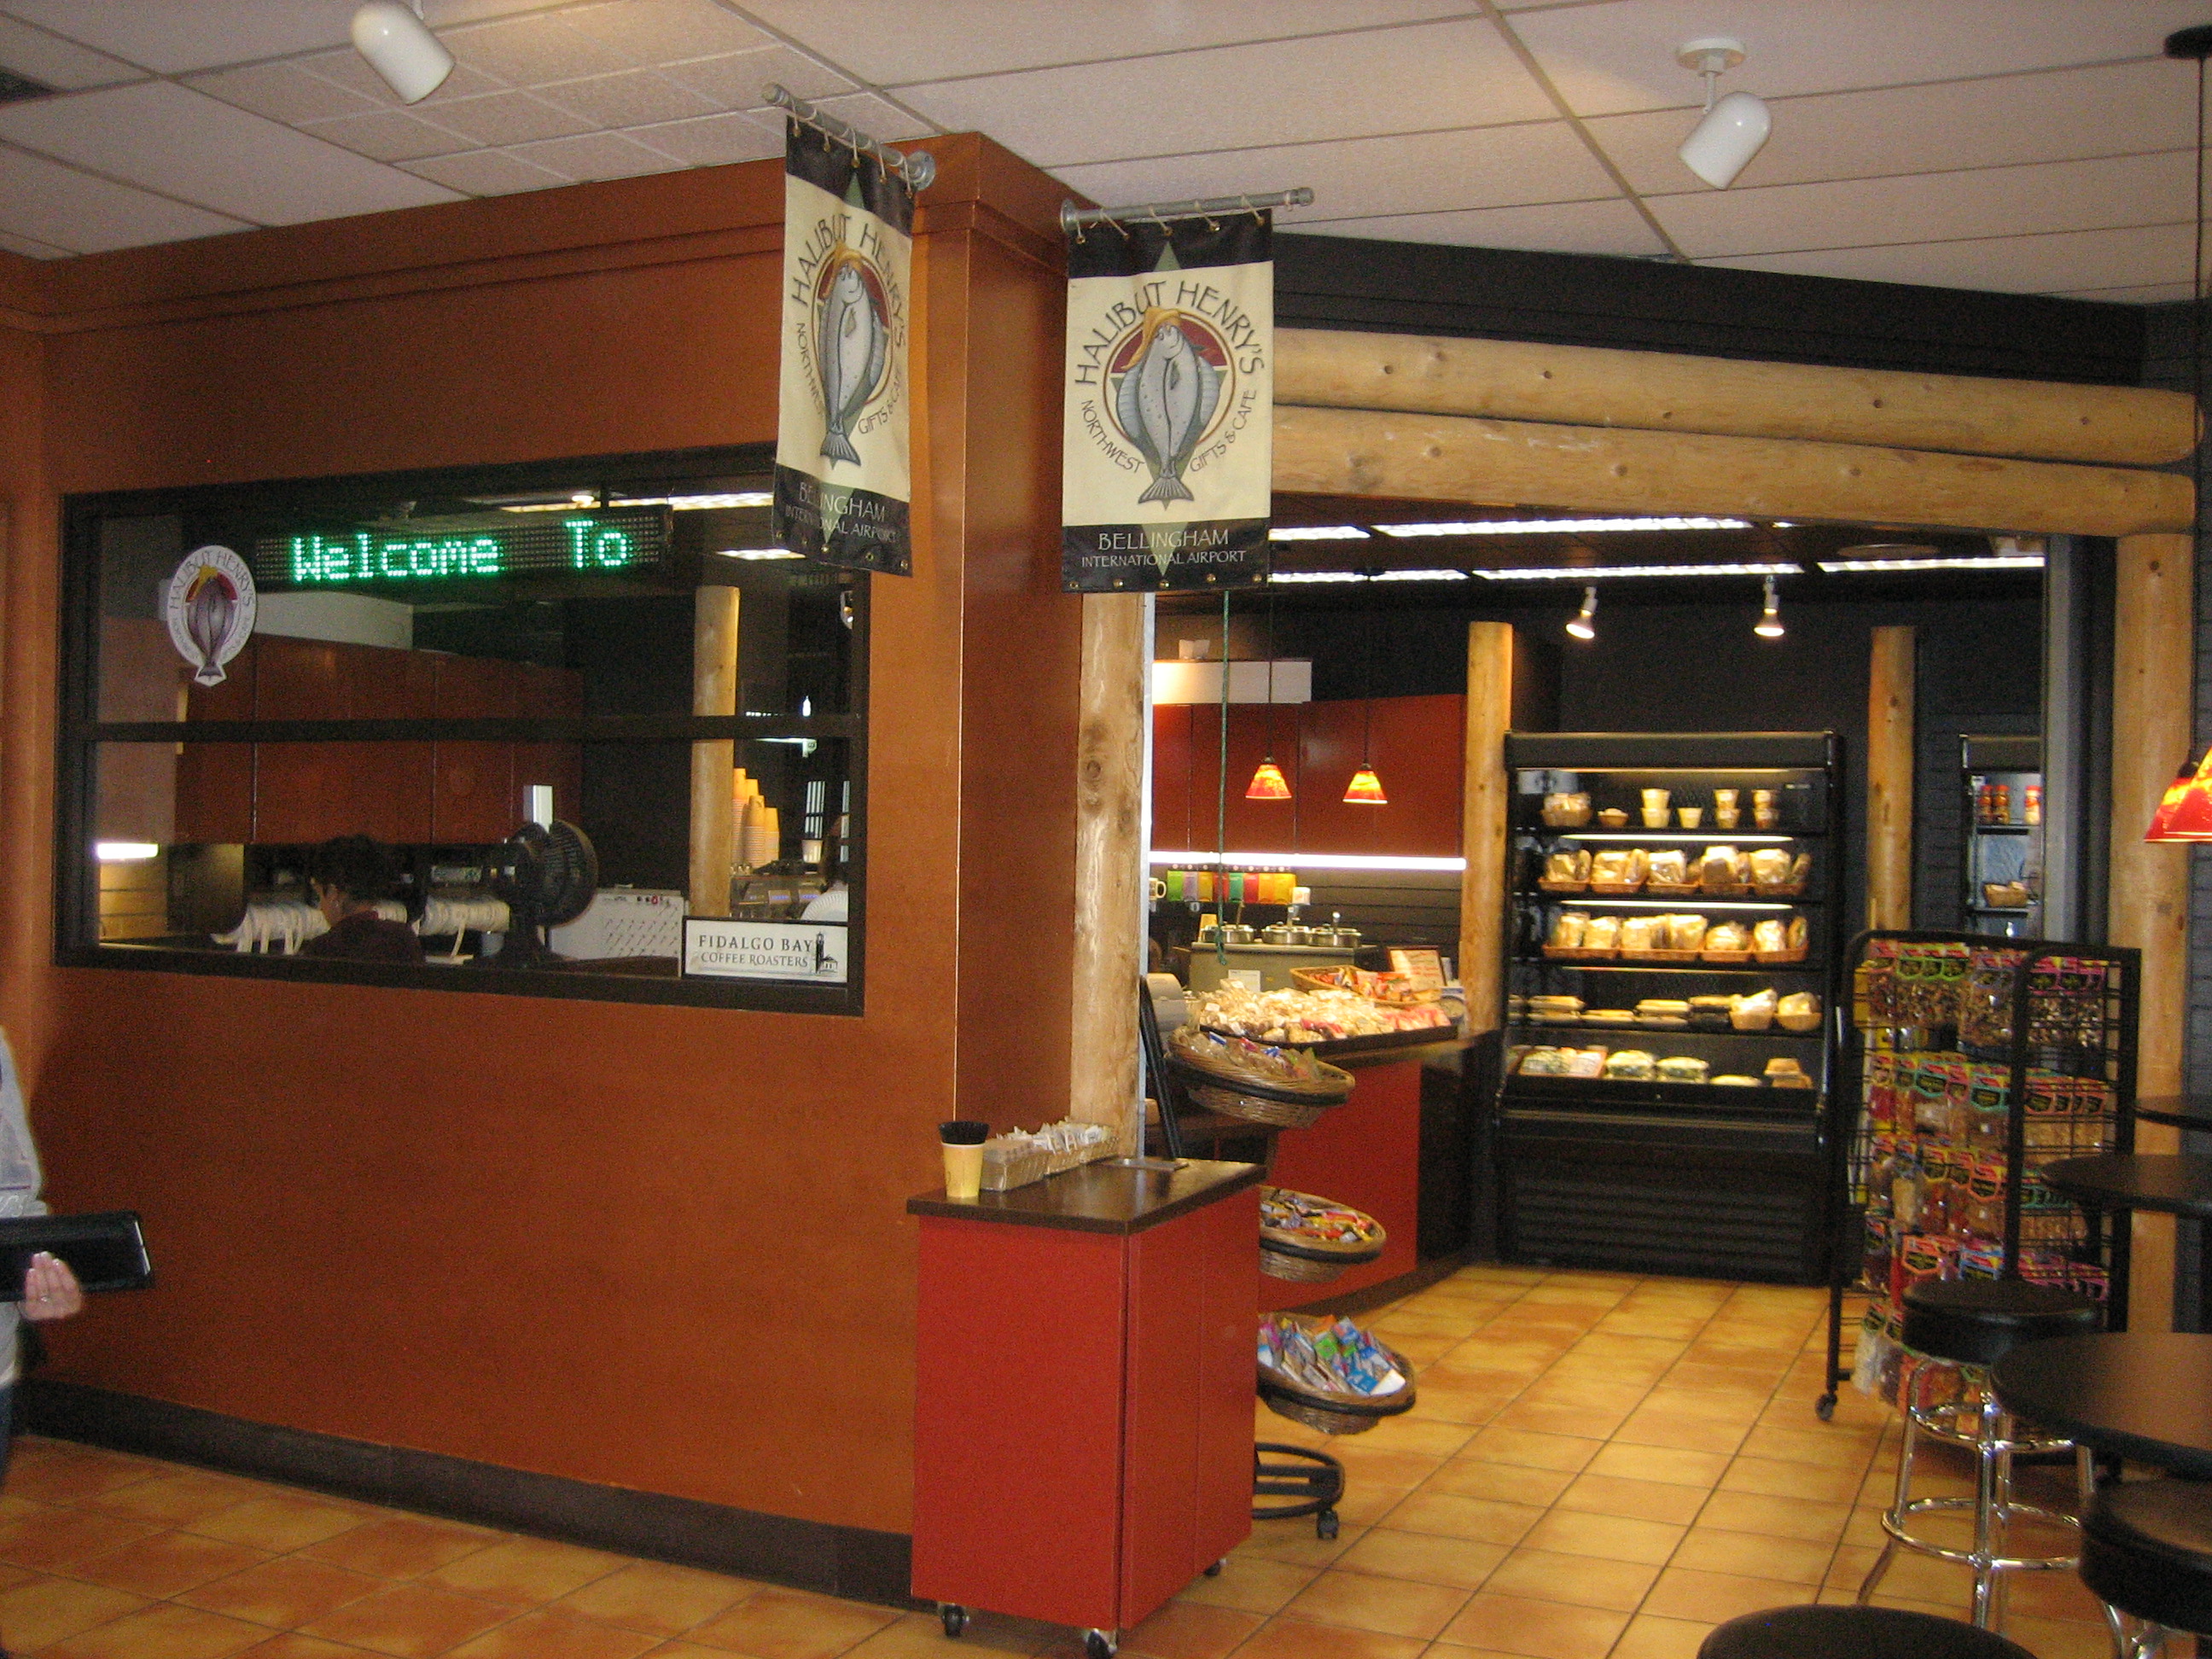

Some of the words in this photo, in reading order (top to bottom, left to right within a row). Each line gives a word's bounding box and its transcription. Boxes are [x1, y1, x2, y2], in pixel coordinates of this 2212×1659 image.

[792, 213, 852, 306] HALIBUT
[1074, 280, 1167, 385] HALIBUT
[1176, 280, 1265, 375] HENRY'S
[858, 407, 888, 434] GIFTS
[1081, 400, 1144, 474] NORTHWEST
[1190, 442, 1227, 472] GIFTS
[1225, 429, 1236, 444] &
[1233, 390, 1256, 431] CAFE
[799, 481, 886, 522] BEINGHAM
[850, 522, 898, 543] AIRPORT
[1097, 529, 1228, 550] BELLINGHAM
[290, 533, 500, 582] Welcome
[564, 519, 629, 568] To
[1081, 552, 1185, 568] INTERNATIONAL
[1187, 550, 1247, 563] AIRPORT
[699, 934, 774, 951] FIDALGO
[781, 938, 813, 952] BAY
[701, 952, 746, 963] COFFEE
[748, 952, 809, 968] ROASTERS
